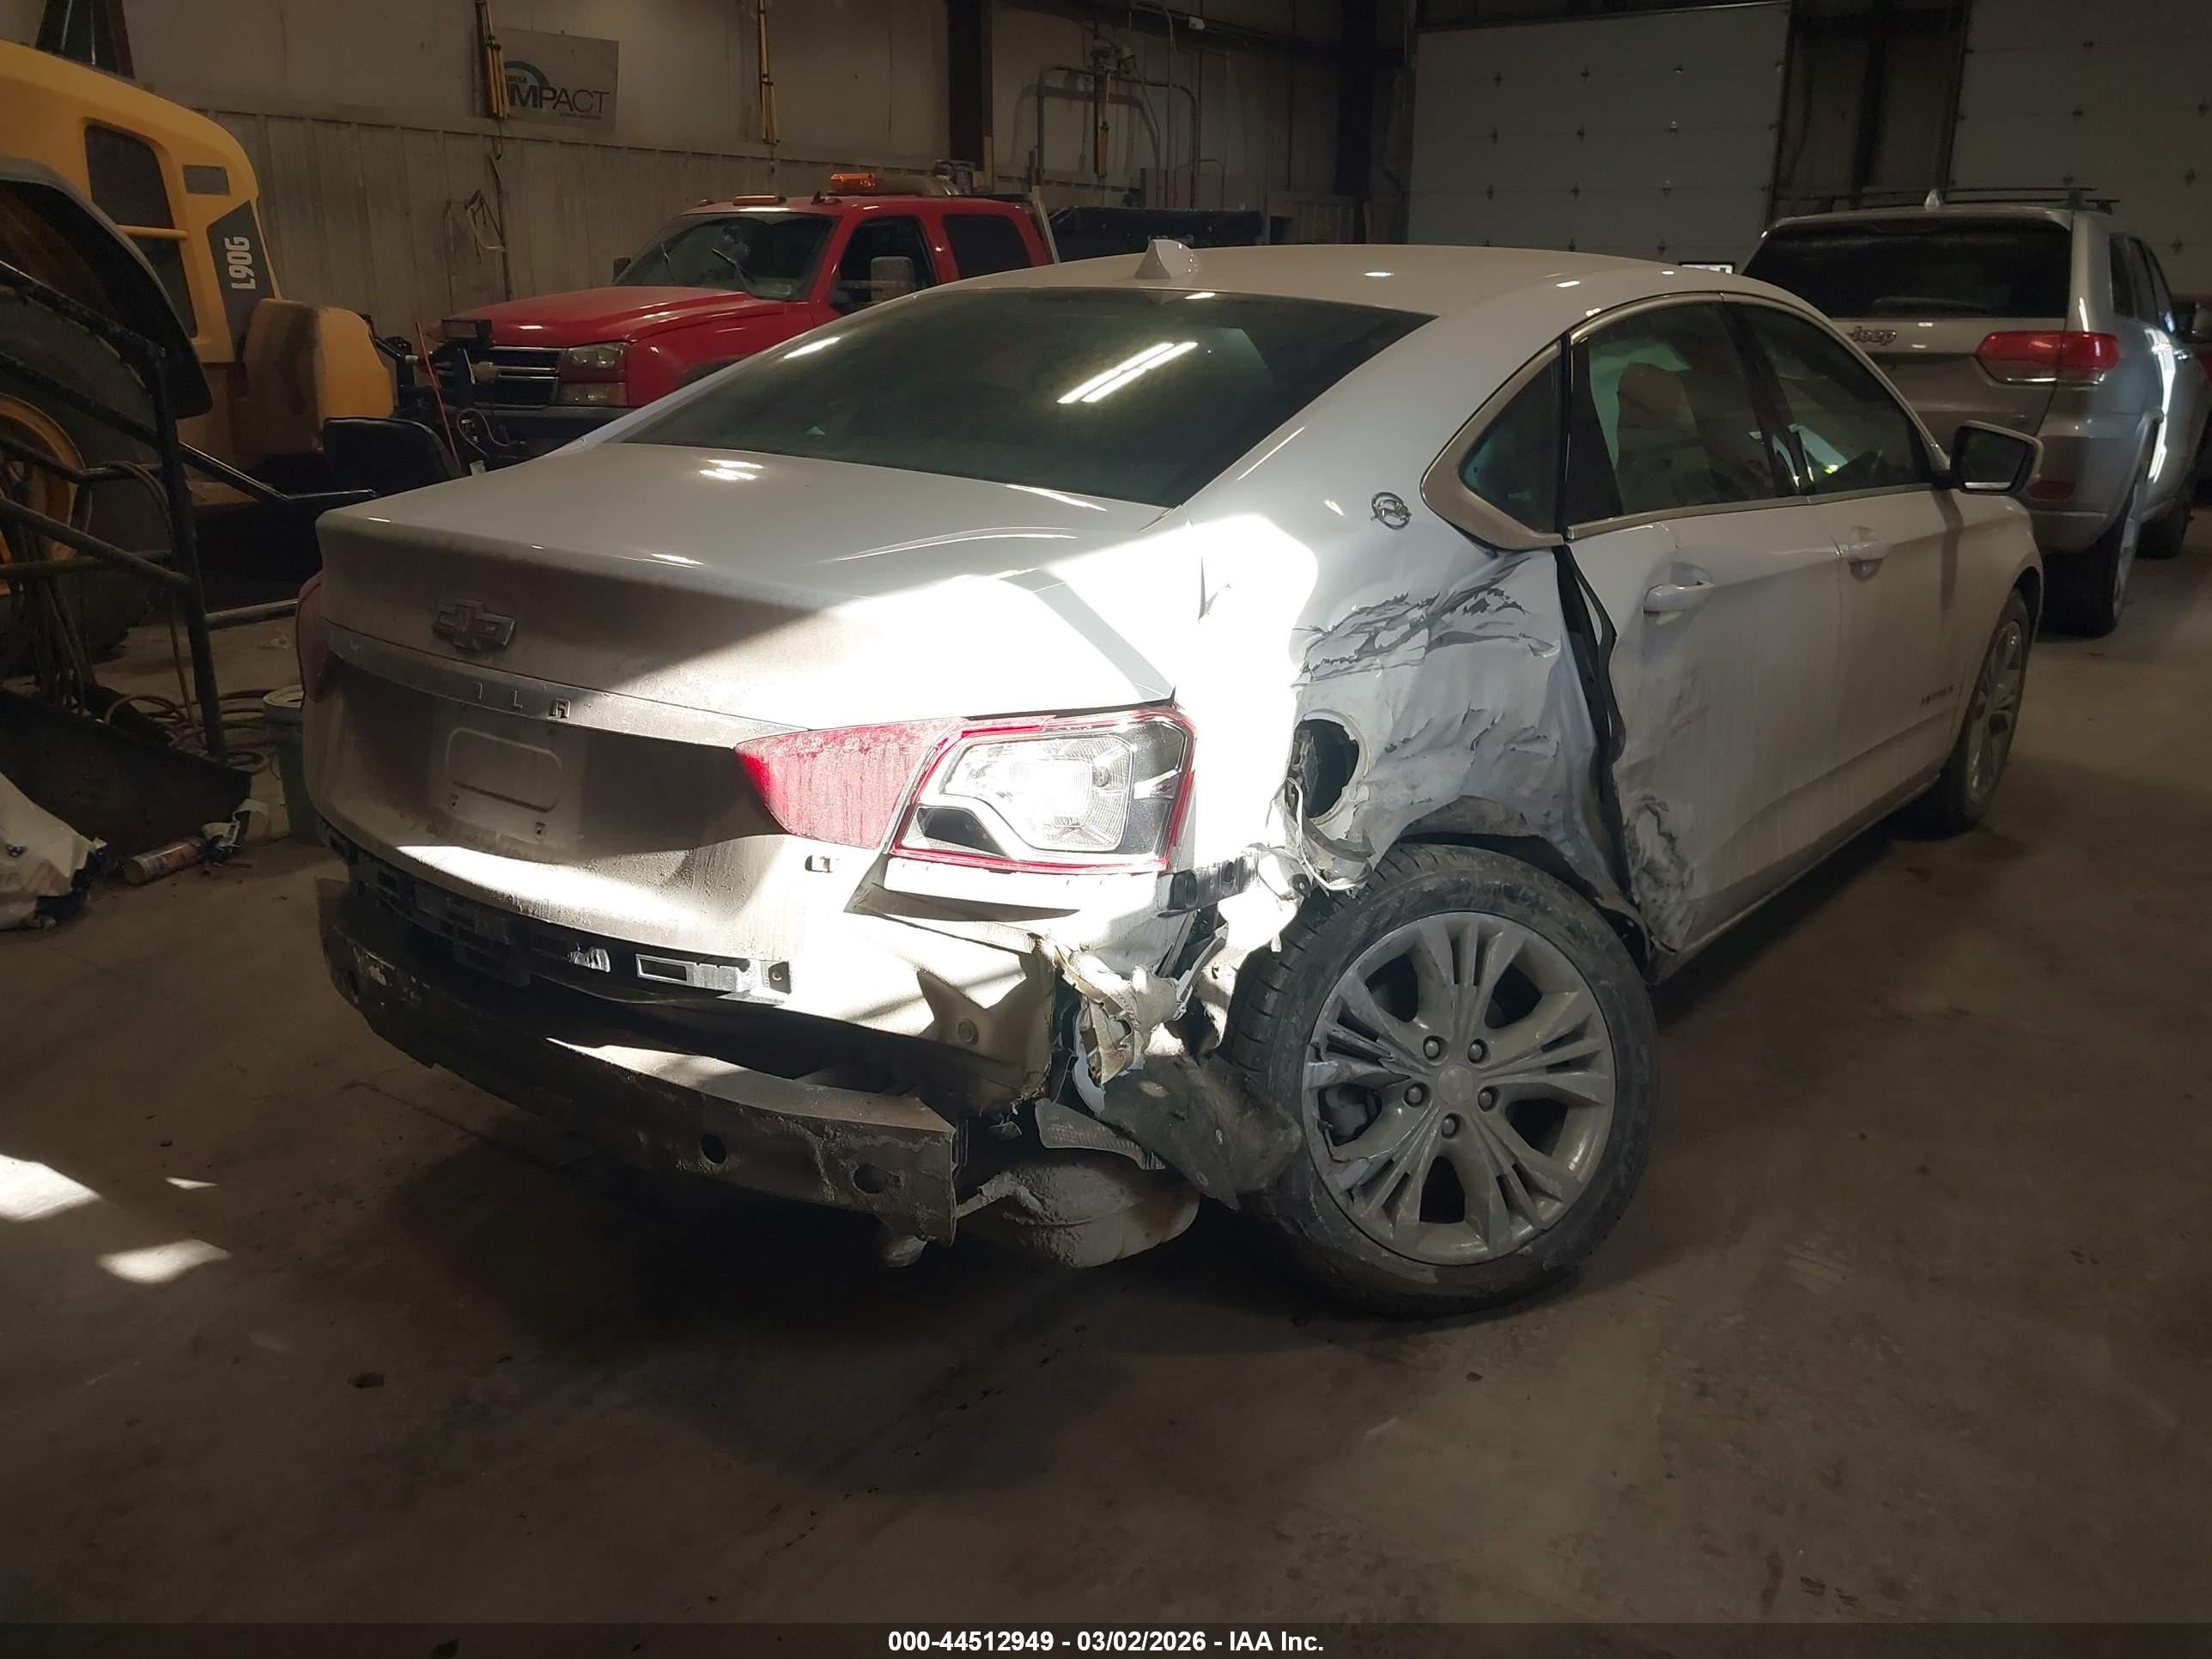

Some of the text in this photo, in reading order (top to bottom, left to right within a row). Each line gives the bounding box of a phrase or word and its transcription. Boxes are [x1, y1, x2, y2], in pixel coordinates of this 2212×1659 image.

[507, 82, 611, 113] MPACT
[224, 236, 256, 289] L90G
[1846, 325, 1897, 346] Jeep
